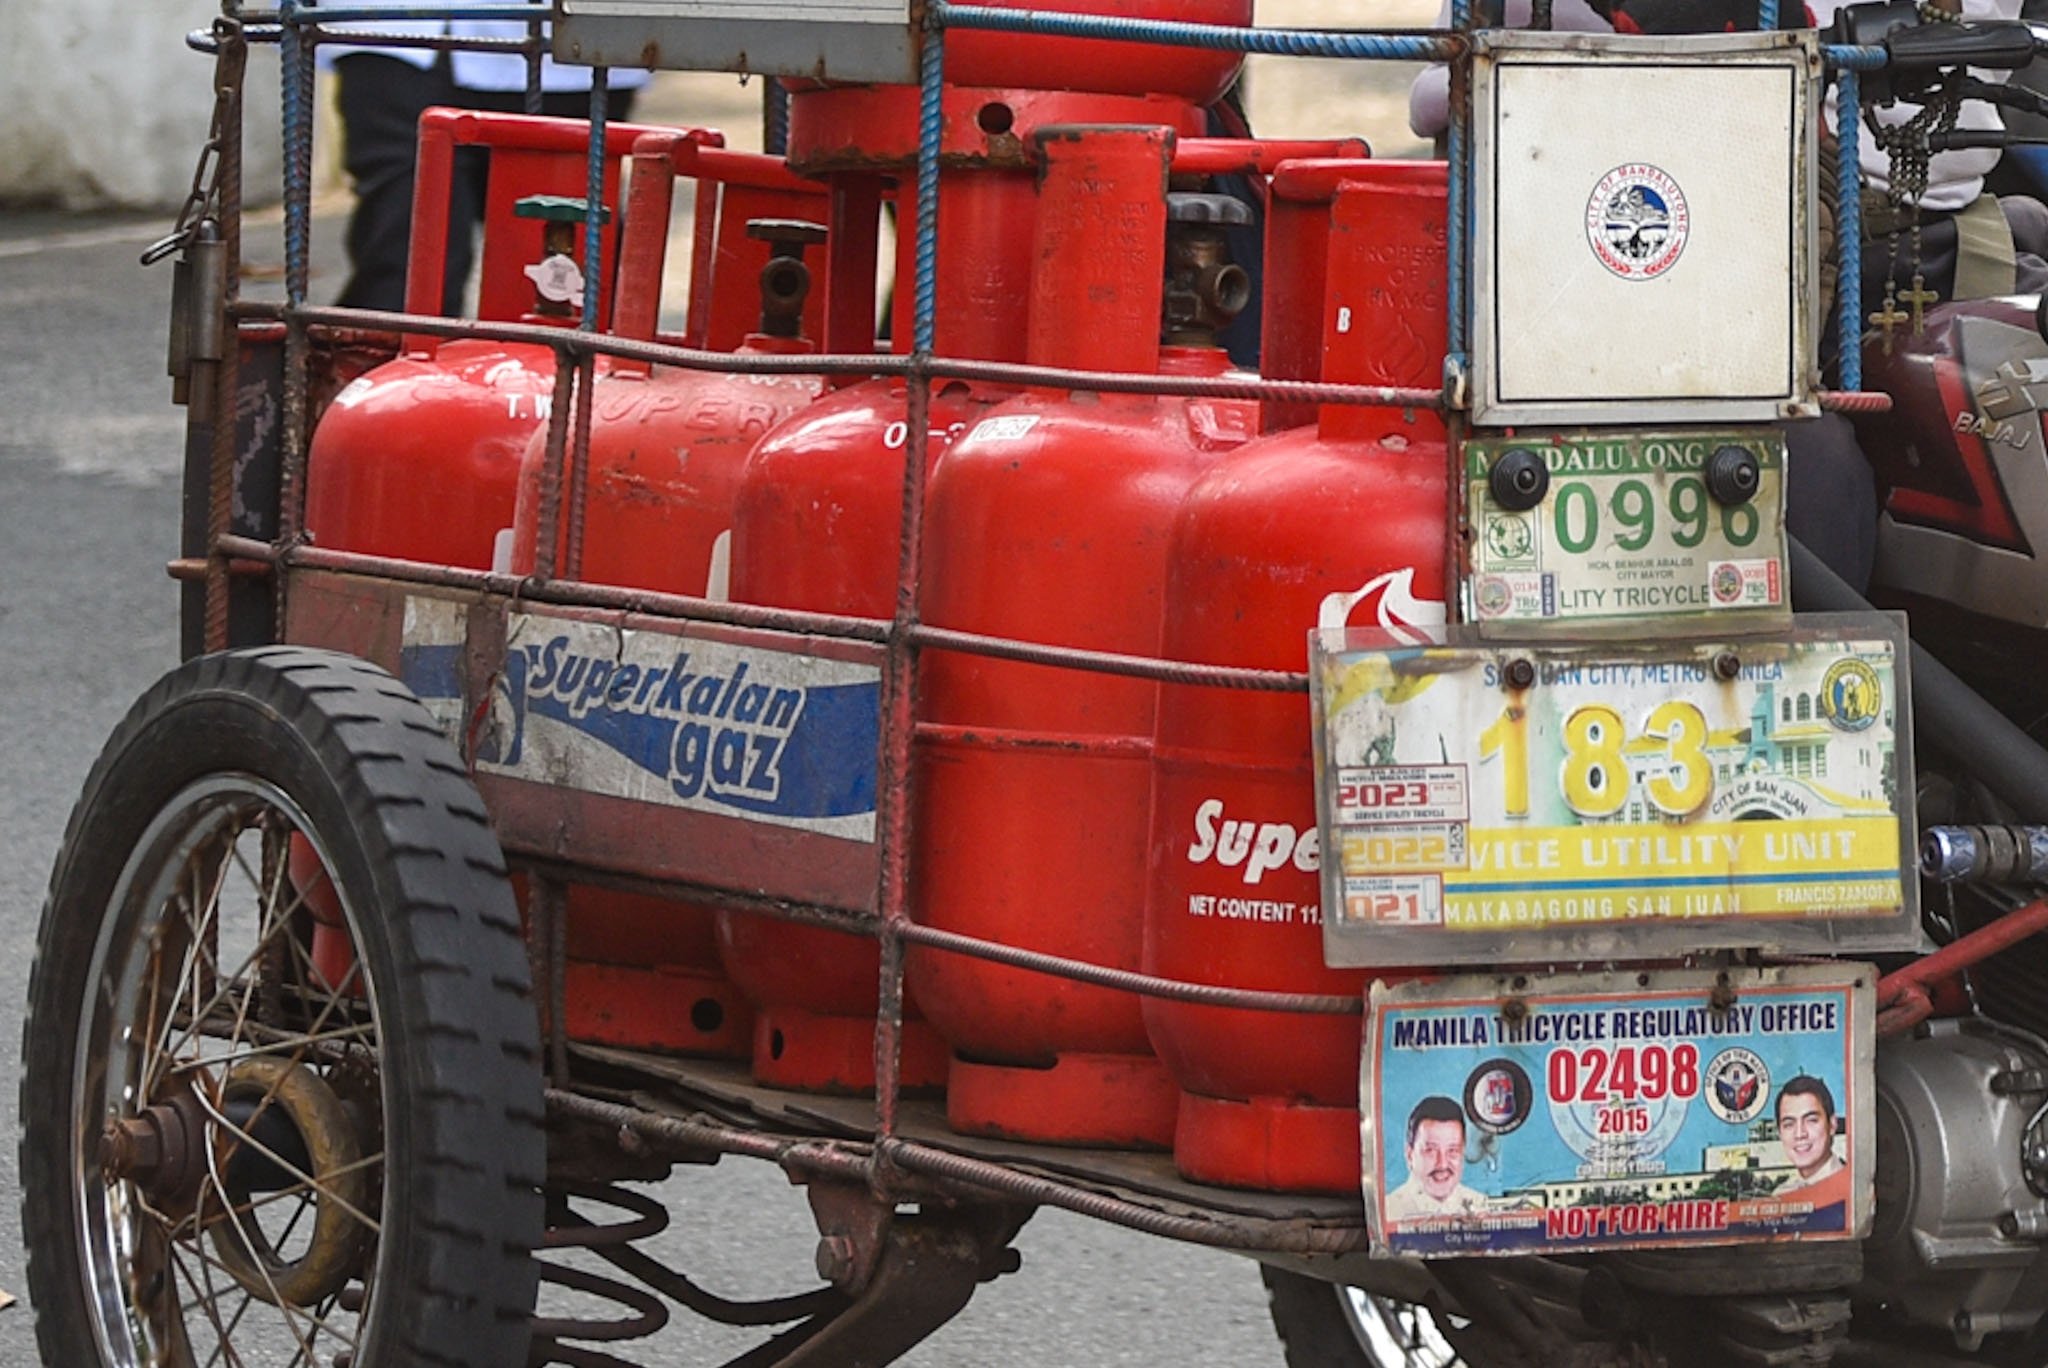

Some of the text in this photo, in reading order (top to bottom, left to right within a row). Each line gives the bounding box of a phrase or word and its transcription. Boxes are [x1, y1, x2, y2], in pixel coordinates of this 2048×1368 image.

[1953, 411, 2031, 449] BAJAJ
[1476, 442, 1704, 475] MDALUYONG
[1617, 569, 1674, 580] CITY MAYOR
[1613, 584, 1710, 607] TRICYCLE
[529, 635, 804, 729] Superkalan
[1589, 663, 1636, 689] CITY,
[671, 721, 782, 799] gaz
[1479, 700, 1715, 819] 183
[1336, 782, 1428, 808] 2023
[1712, 790, 1736, 815] CITY
[1755, 780, 1778, 796] SAN
[1780, 789, 1808, 816] JUAN
[1187, 798, 1321, 884] Supe
[1342, 836, 1446, 866] 2022
[1581, 833, 1745, 868] UTILITY
[1763, 830, 1857, 862] UNIT
[1189, 894, 1217, 917] NET
[1217, 897, 1296, 923] CONTENT
[1445, 891, 1742, 923] MAKABAGONG SAN JUAN
[1776, 884, 1837, 904] FRANCIS
[1393, 1002, 1836, 1048] MANILA TRICYCLE REGULATORY OFFICE
[1548, 1043, 1699, 1105] 02498
[1598, 1107, 1650, 1135] 2015
[1546, 1207, 1602, 1238] NOT
[1607, 1203, 1659, 1235] FOR
[1664, 1200, 1728, 1232] HIRE
